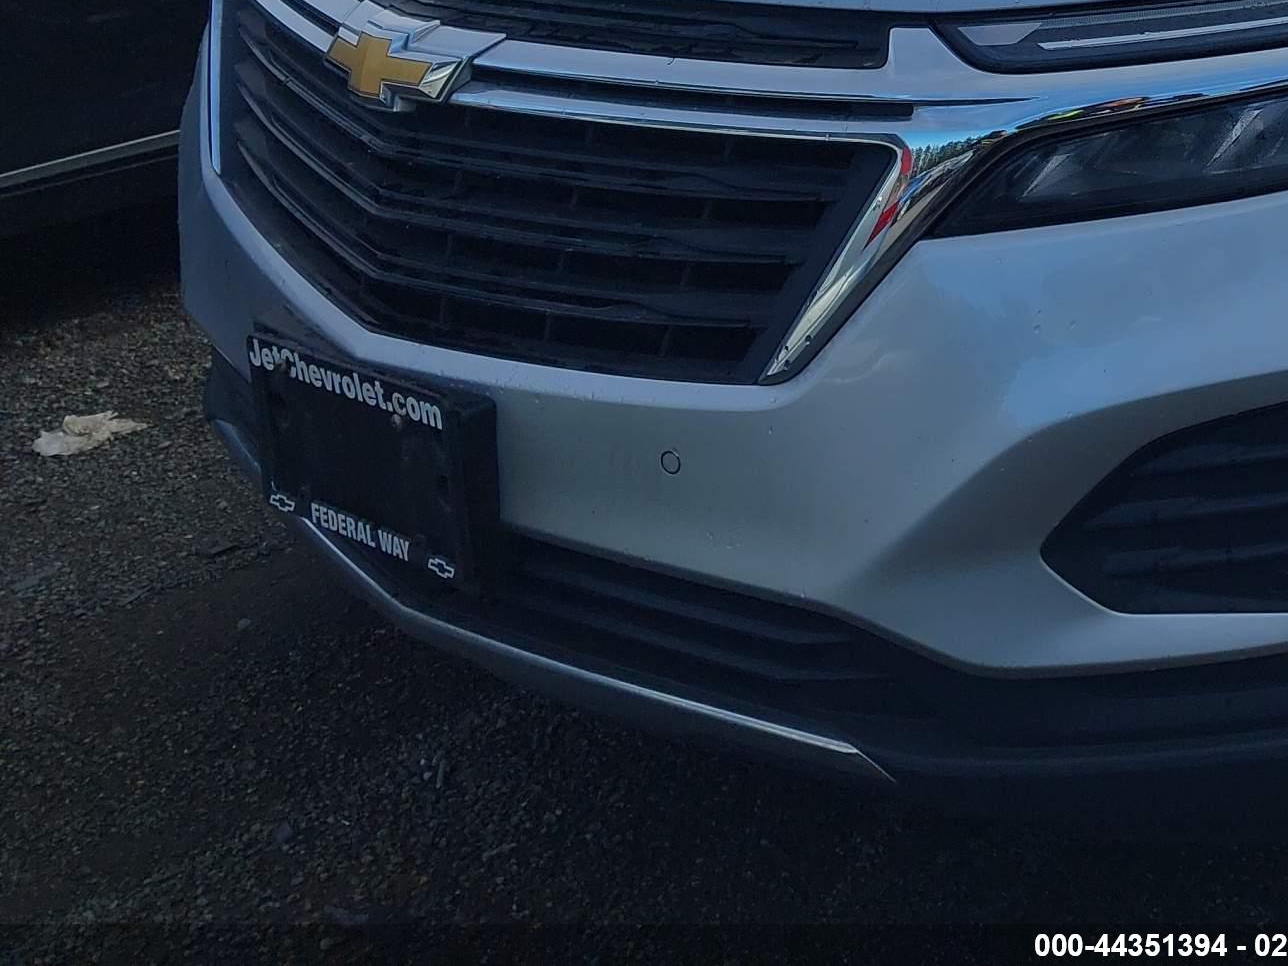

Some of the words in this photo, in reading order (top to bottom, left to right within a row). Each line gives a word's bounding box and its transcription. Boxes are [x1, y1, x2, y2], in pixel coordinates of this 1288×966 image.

[249, 337, 443, 431] JetChevrolet.com
[311, 502, 377, 549] FEDERAL
[378, 529, 410, 562] WAY
